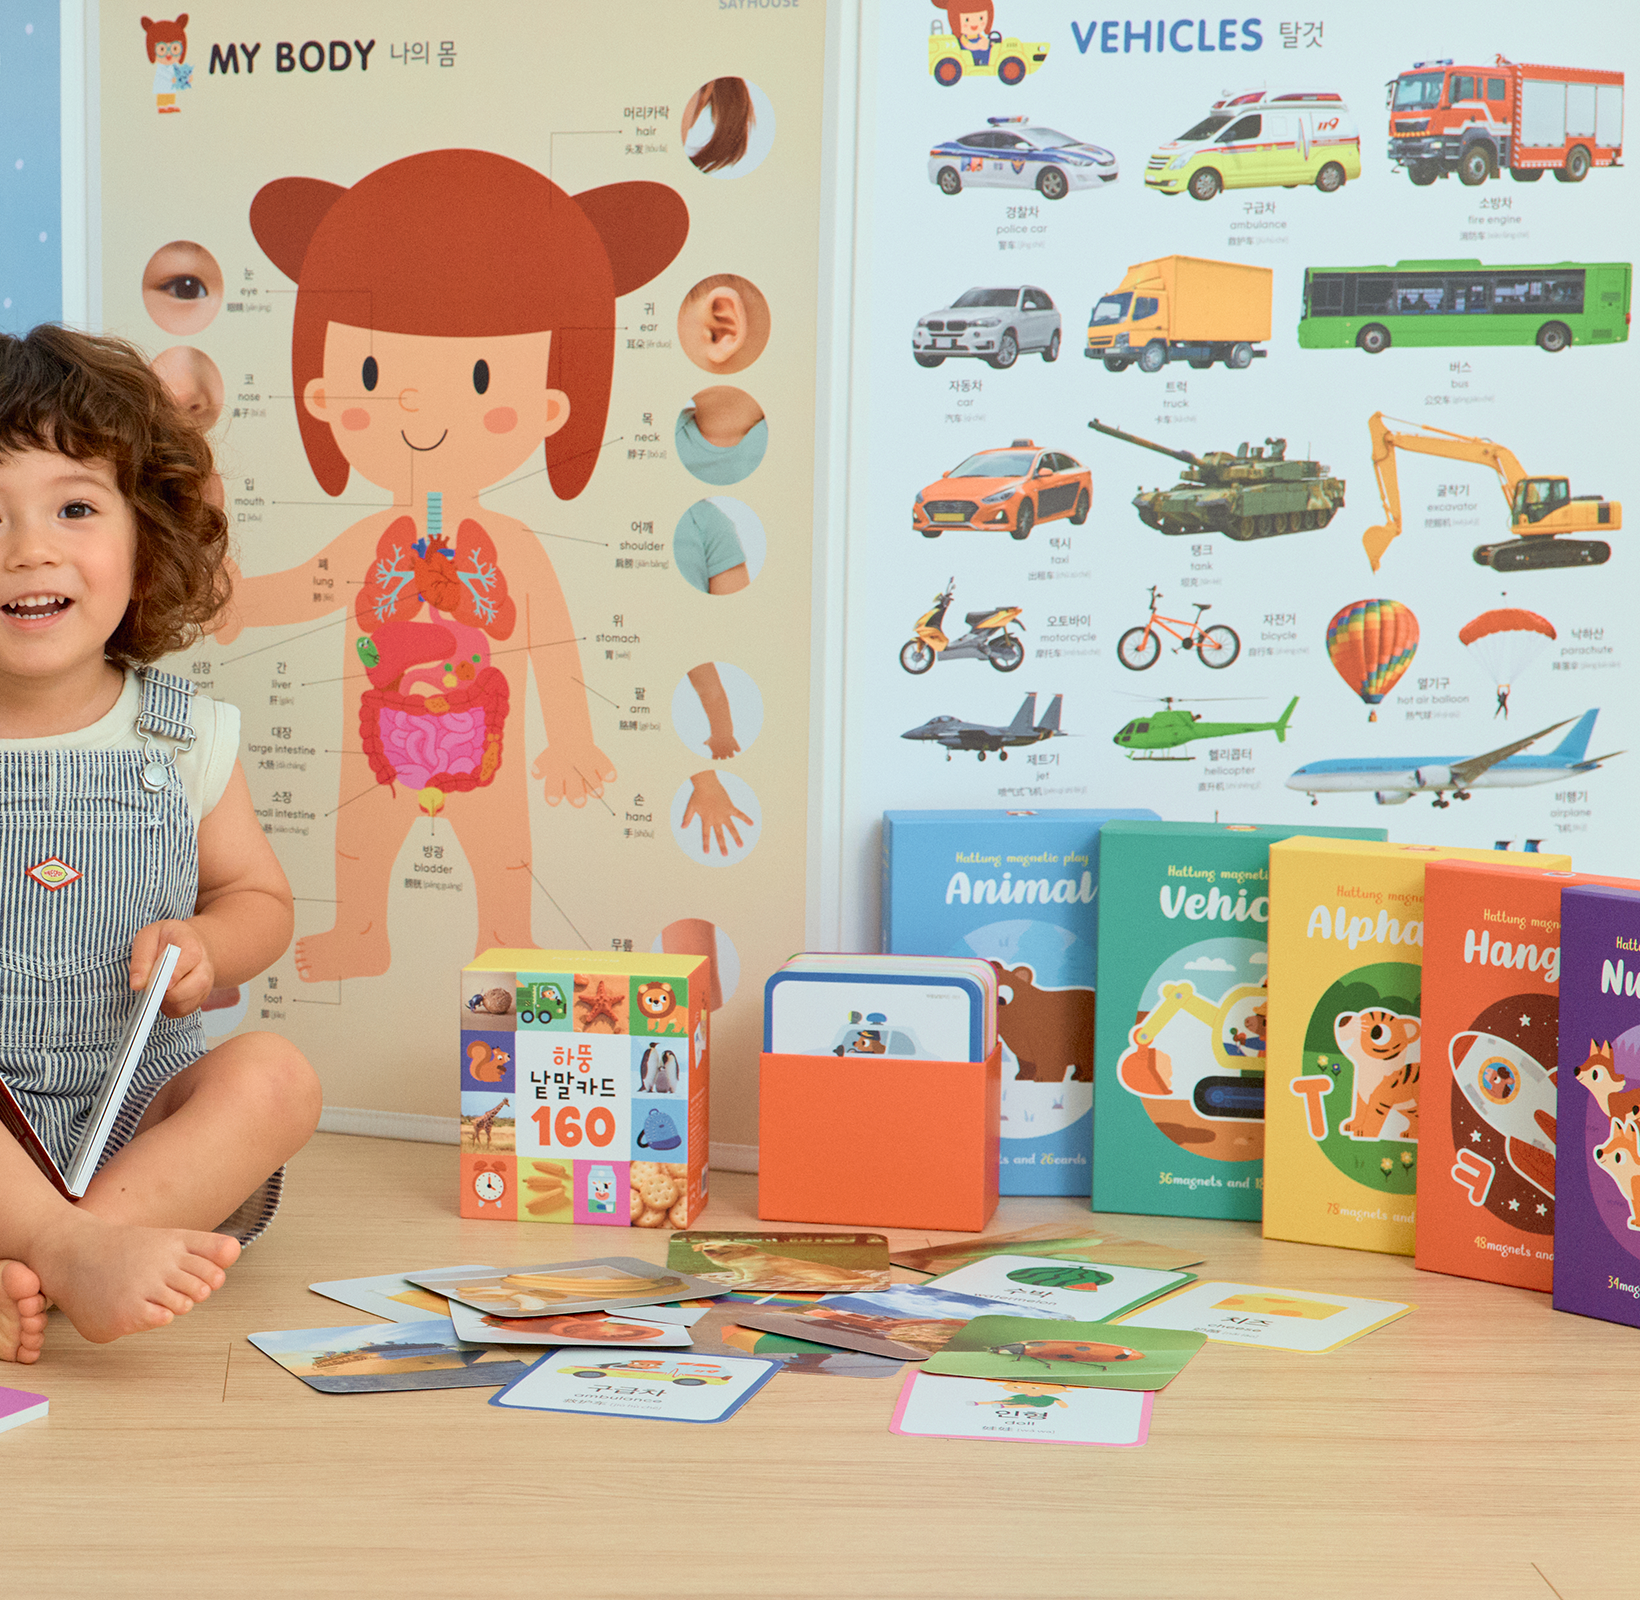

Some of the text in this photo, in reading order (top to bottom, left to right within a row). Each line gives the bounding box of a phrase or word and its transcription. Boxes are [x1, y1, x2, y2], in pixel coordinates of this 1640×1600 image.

[1071, 18, 1323, 54] VEHICLES 탈것
[209, 40, 457, 74] MY BODY 나의 몸
[623, 106, 670, 119] 머리카락
[1243, 202, 1277, 214] 구급차
[1479, 197, 1513, 209] 소방차
[1006, 206, 1040, 219] 경찰차
[1229, 220, 1288, 230] ambulance
[1467, 216, 1523, 226] fire engine
[995, 225, 1048, 235] police car
[1449, 362, 1472, 373] 버스
[948, 380, 983, 392] 자동차
[1165, 381, 1188, 393] 트럭
[634, 433, 660, 442] neck
[1437, 485, 1470, 497] 굴착기
[234, 498, 265, 506] mouth
[630, 521, 654, 534] 어깨
[619, 541, 665, 551] shoulder
[1048, 538, 1072, 549] 택시
[1190, 544, 1213, 556] 탱크
[312, 577, 335, 588] lung
[1047, 615, 1091, 627] 오토바이
[1263, 614, 1297, 626] 자전거
[595, 634, 641, 643] stomach
[1039, 633, 1098, 643] motorcycle
[1260, 631, 1298, 641] bicycle
[1570, 628, 1605, 640] 낙하산
[1560, 646, 1614, 656] parachute
[1417, 678, 1451, 690] 열기구
[271, 727, 293, 739] 대장
[247, 744, 316, 755] large intestine
[1208, 749, 1253, 761] 헬리콥터
[1026, 754, 1060, 765] 제트기
[1203, 767, 1256, 776] helicopter
[271, 791, 293, 804] 소장
[1554, 791, 1588, 803] 비행기
[276, 810, 316, 820] intestine
[625, 812, 653, 822] hand
[422, 846, 445, 859] 방광
[955, 852, 1090, 867] Hattung magnetic play
[413, 863, 453, 874] bladder
[1167, 865, 1216, 882] Hattung
[945, 871, 1097, 905] Animal
[1337, 885, 1383, 905] Hattung
[1484, 909, 1526, 929] Hattung
[1307, 905, 1423, 950] Alpha
[1464, 929, 1561, 983] Hang
[263, 994, 283, 1004] foot
[553, 1044, 592, 1073] 하뚱
[531, 1071, 615, 1100] 낱말카드
[1291, 1075, 1334, 1140] T
[531, 1106, 615, 1147] 160
[1012, 1153, 1088, 1166] and 26cards
[1158, 1172, 1250, 1190] 36magnets and
[1326, 1202, 1416, 1223] 78magnets and
[1474, 1236, 1531, 1257] 48magnets
[1007, 1288, 1053, 1298] 수박
[973, 1293, 1058, 1306] watermelon
[1206, 1322, 1262, 1333] cheese
[1219, 1316, 1274, 1327] 치즈
[586, 1384, 668, 1398] 구급차
[573, 1393, 664, 1404] ambulance
[995, 1411, 1049, 1419] 인형
